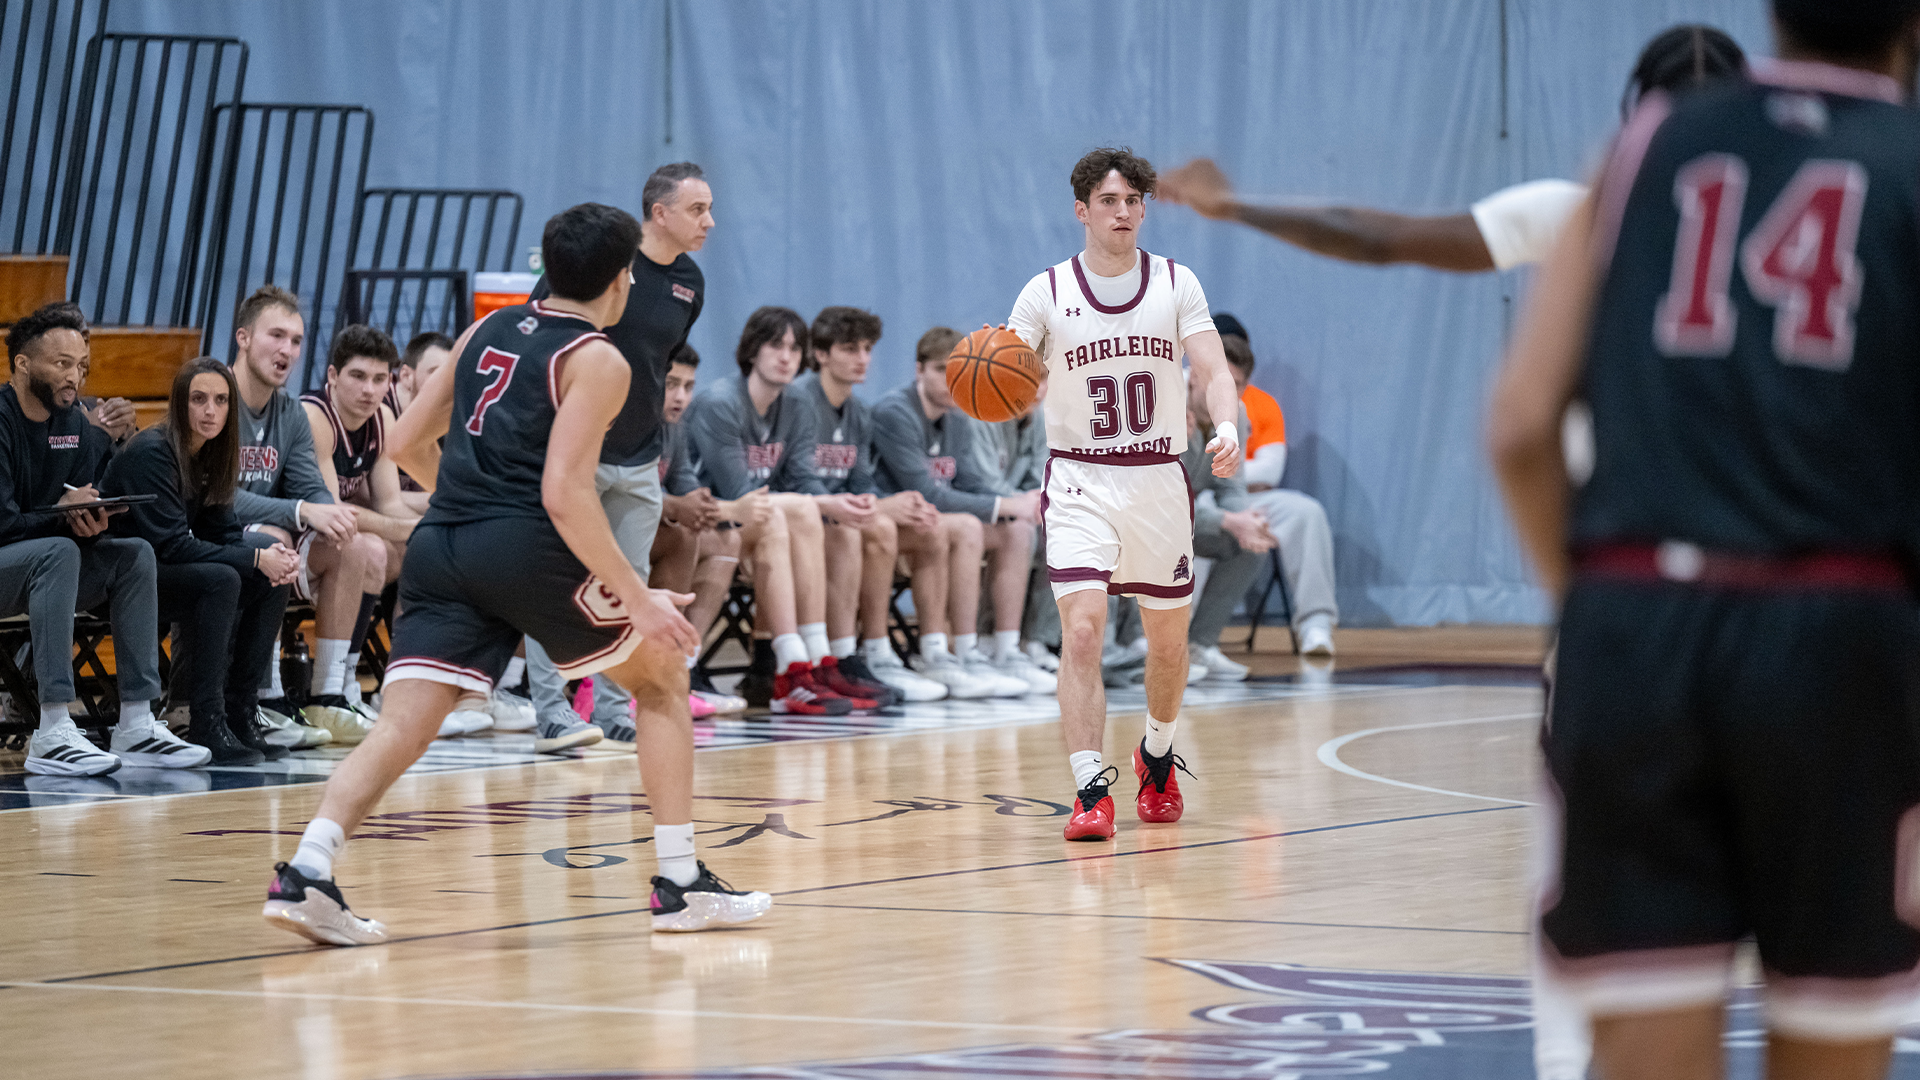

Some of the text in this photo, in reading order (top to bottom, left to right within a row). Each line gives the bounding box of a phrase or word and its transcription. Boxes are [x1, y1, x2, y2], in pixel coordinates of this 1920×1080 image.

[1654, 153, 1867, 371] 14
[465, 345, 520, 436] 7
[1064, 336, 1174, 371] FAIRLEIGH
[1087, 371, 1156, 440] 30
